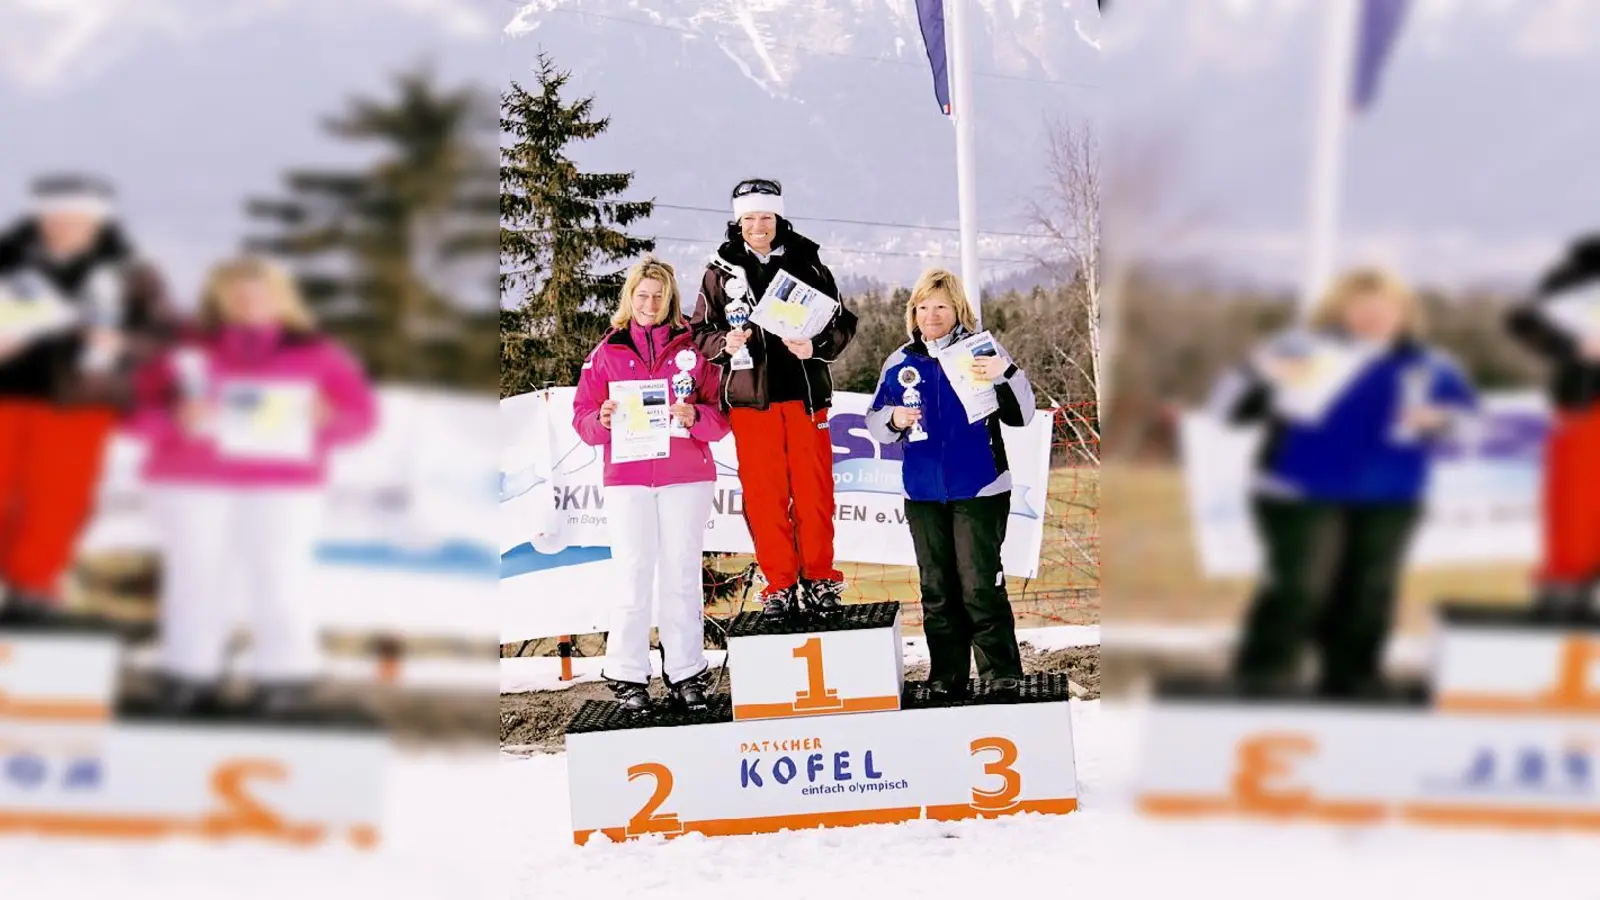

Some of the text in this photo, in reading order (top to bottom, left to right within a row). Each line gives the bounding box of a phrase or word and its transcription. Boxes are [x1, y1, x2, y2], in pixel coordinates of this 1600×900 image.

[792, 637, 844, 710] 1
[740, 737, 822, 753] PATSCHER
[740, 750, 883, 789] KOFEL
[625, 762, 683, 836] 2
[801, 779, 908, 795] einfach olympisch
[969, 736, 1021, 811] 3
